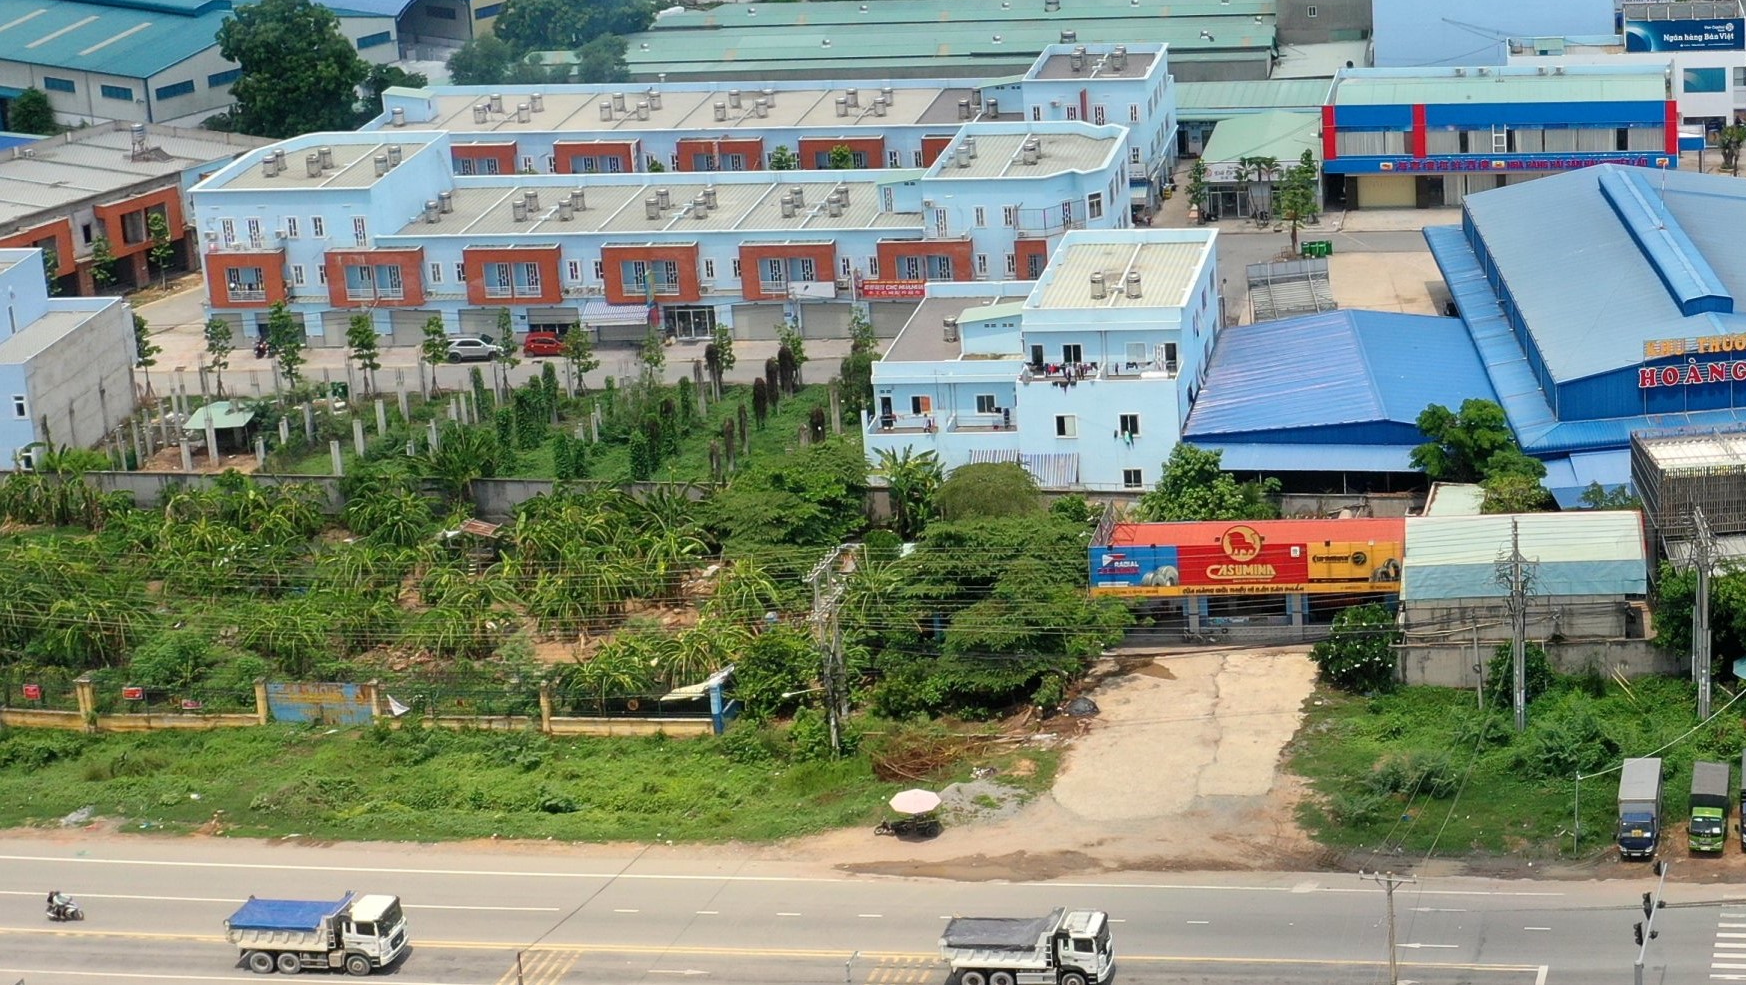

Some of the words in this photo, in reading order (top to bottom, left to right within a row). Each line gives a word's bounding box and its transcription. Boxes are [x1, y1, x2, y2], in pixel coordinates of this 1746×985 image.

[1663, 33, 1683, 42] Ngân
[1684, 32, 1703, 42] hàng
[1719, 31, 1734, 41] Việt
[1646, 341, 1685, 357] KHU
[1206, 564, 1277, 580] CASUMINA
